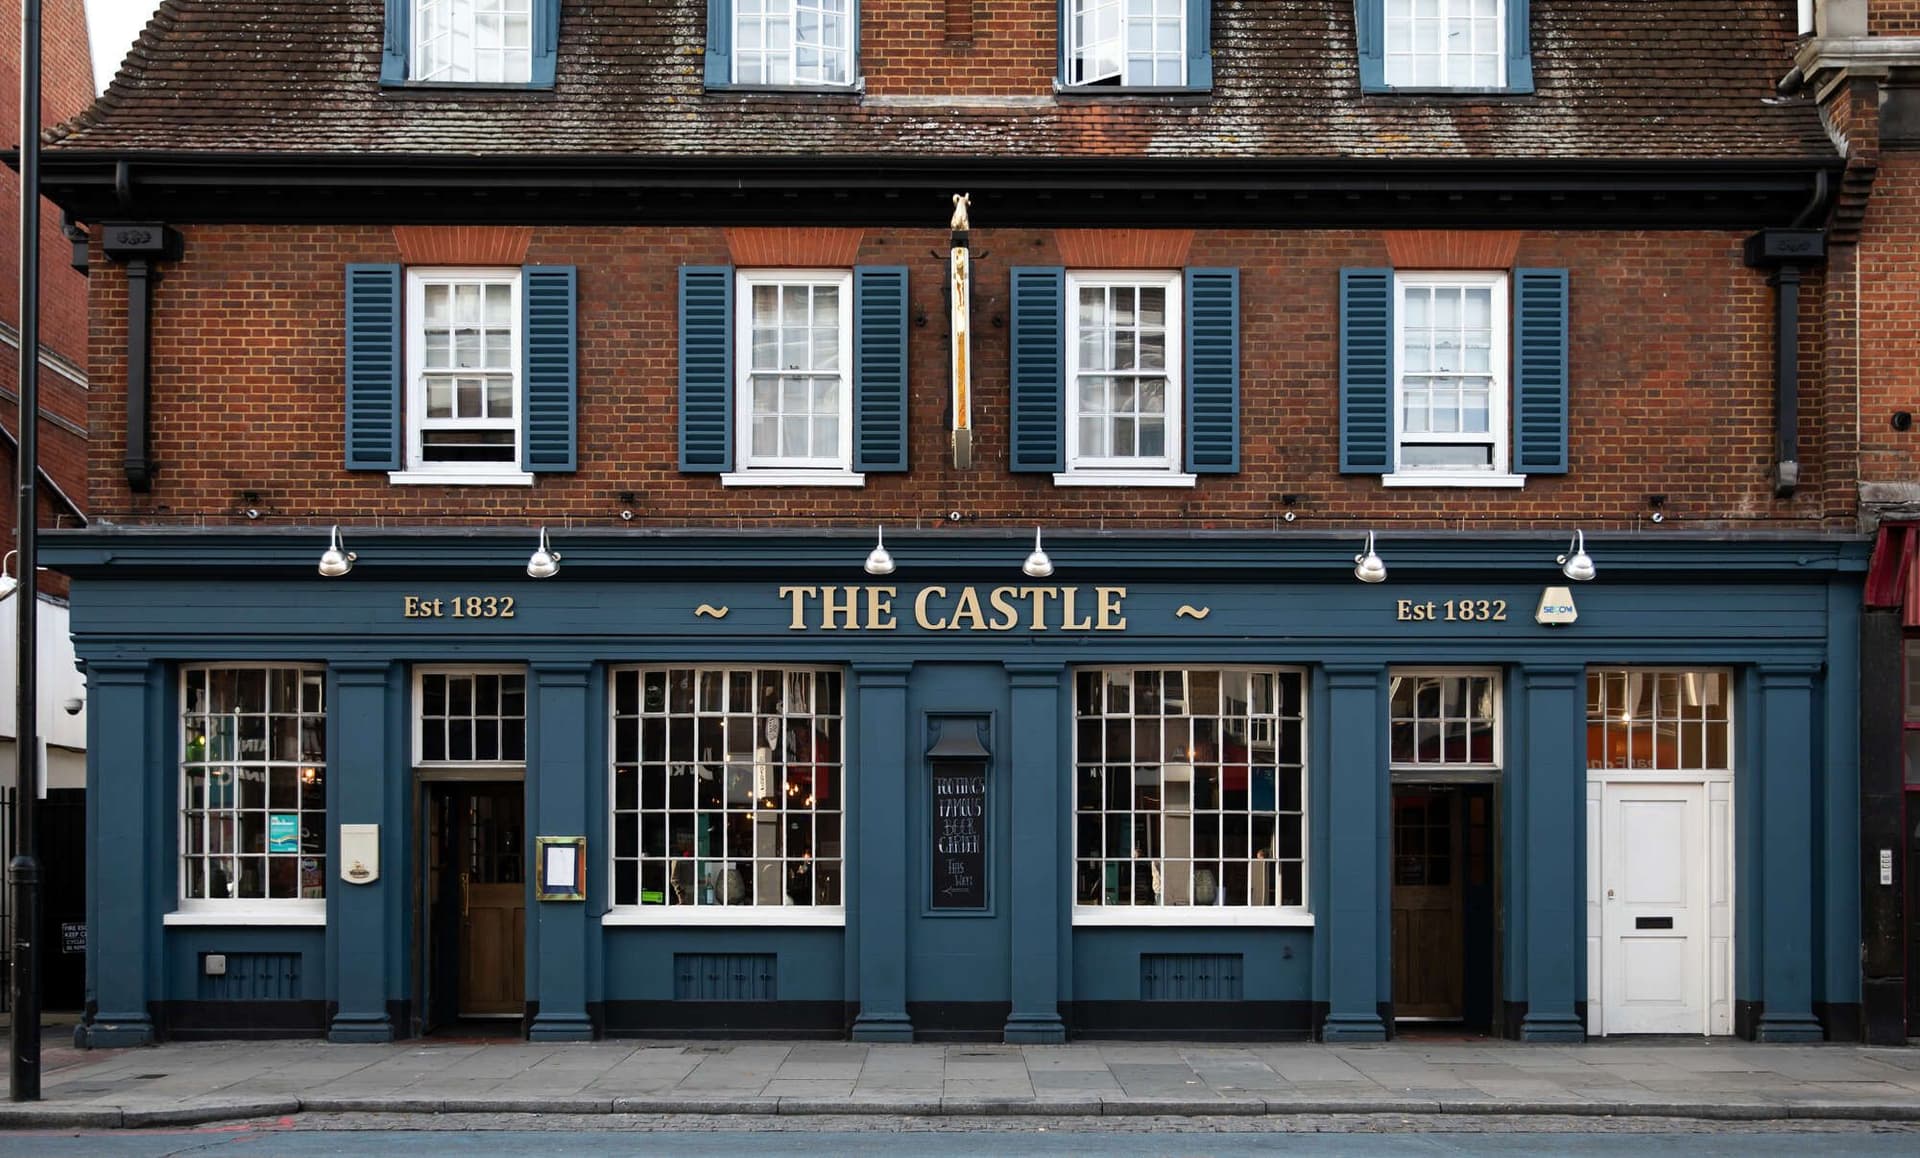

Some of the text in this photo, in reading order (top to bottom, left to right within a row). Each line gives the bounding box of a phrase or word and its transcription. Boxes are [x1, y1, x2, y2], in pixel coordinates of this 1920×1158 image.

[404, 596, 515, 618] Est 1832
[778, 585, 1127, 632] THE CASTLE
[1397, 600, 1507, 621] Est 1832
